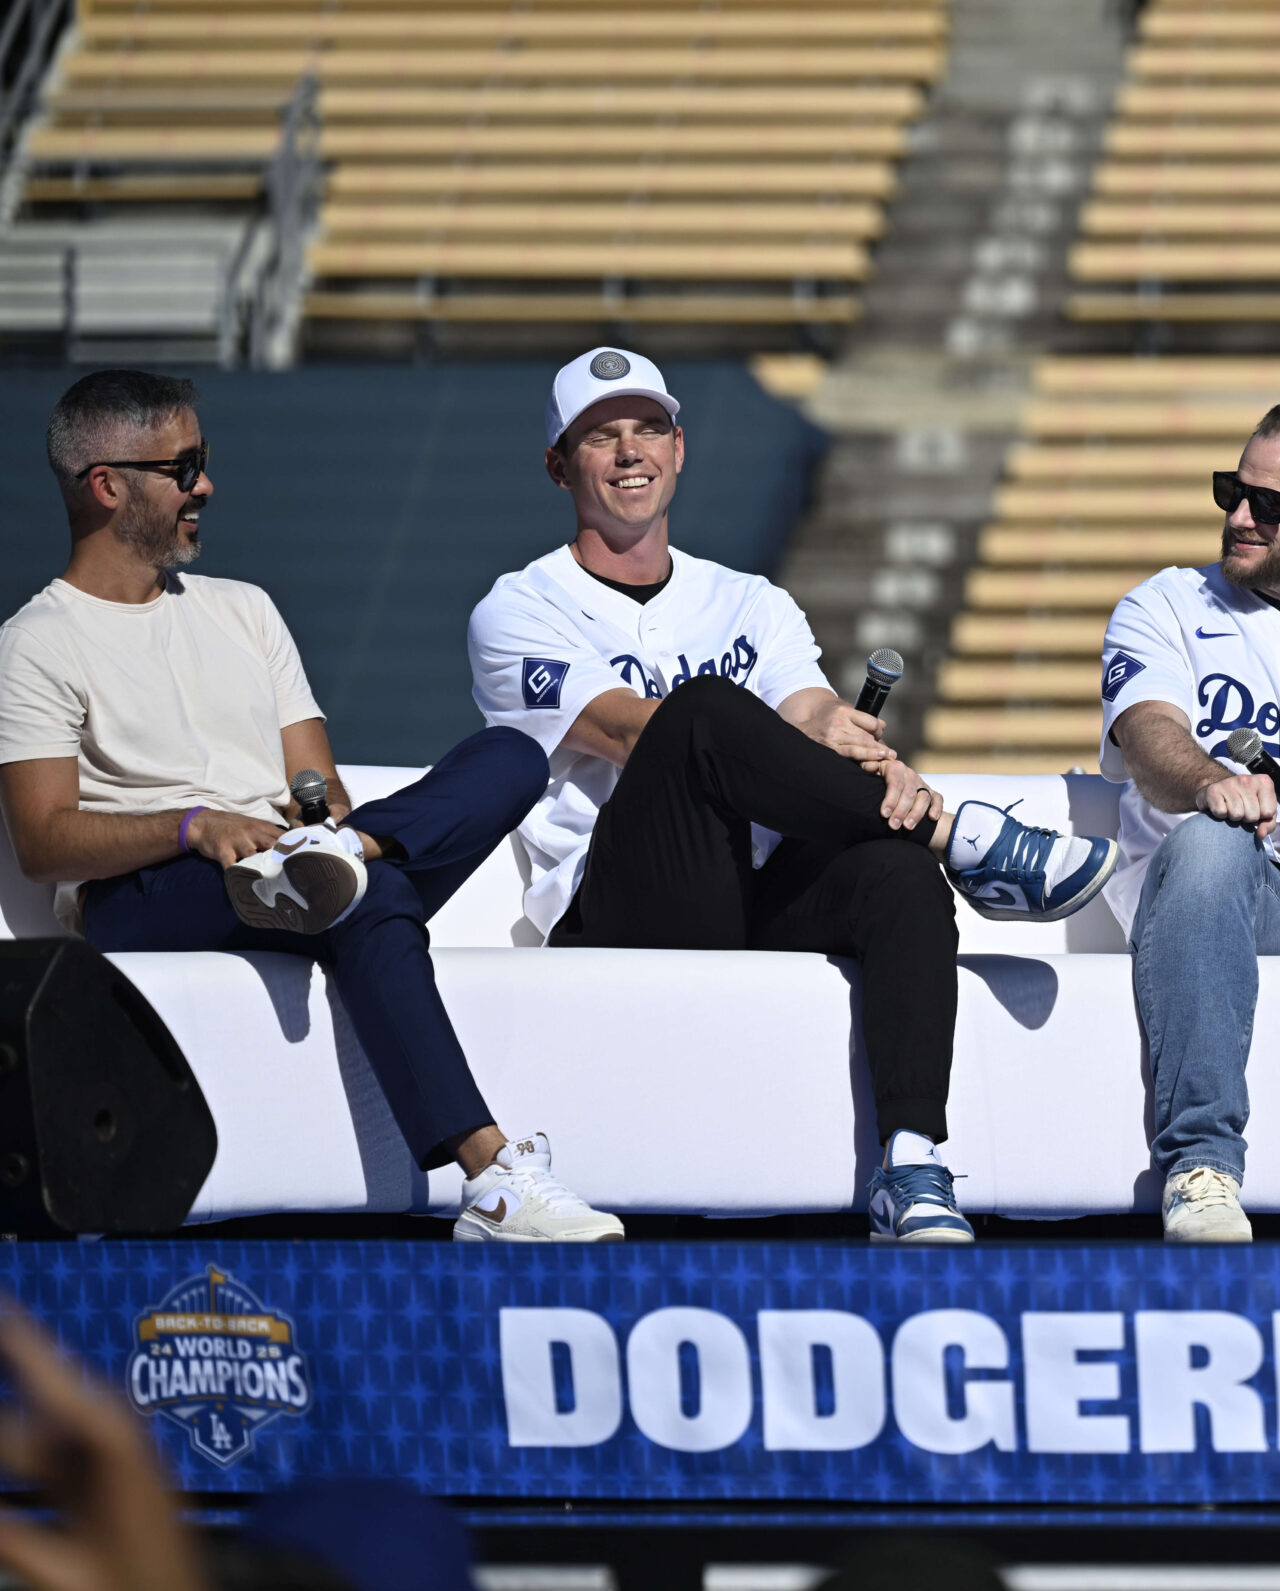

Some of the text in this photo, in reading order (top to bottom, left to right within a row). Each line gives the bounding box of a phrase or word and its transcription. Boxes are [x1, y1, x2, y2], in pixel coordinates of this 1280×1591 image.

[150, 1343, 172, 1356] 24
[174, 1337, 252, 1359] WORLD
[132, 1354, 308, 1407] CHAMPIONS
[210, 1414, 232, 1449] LA
